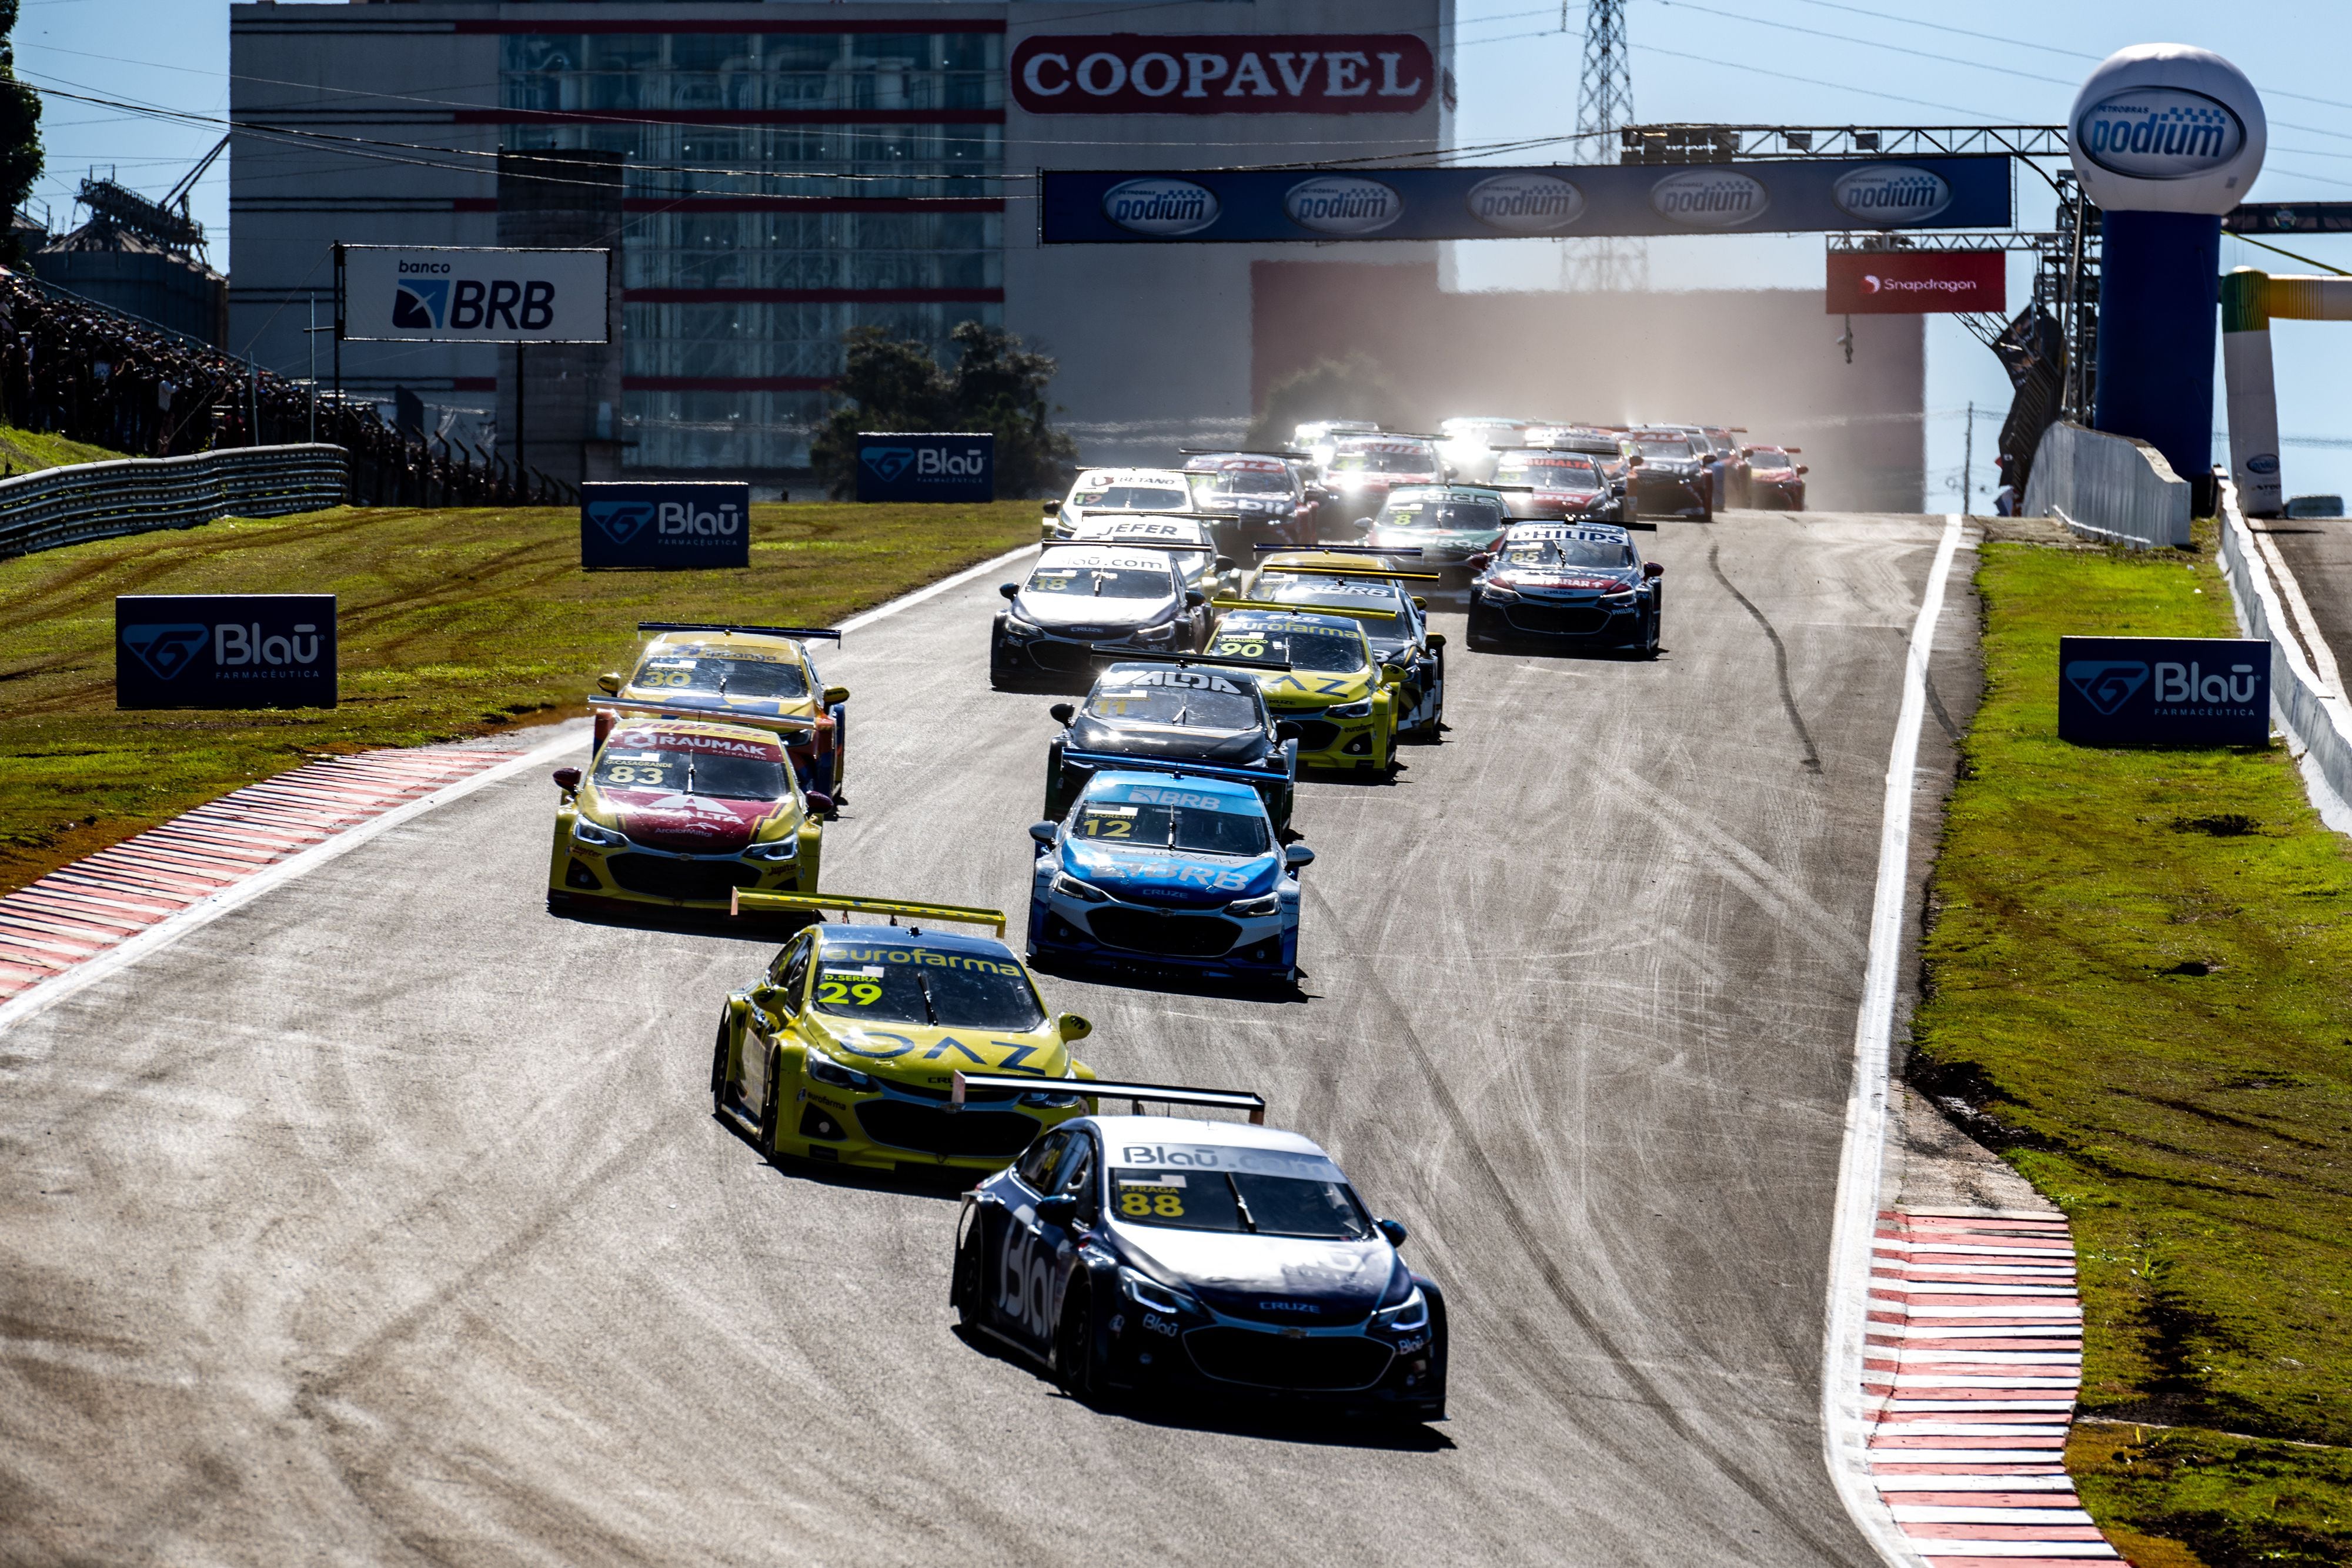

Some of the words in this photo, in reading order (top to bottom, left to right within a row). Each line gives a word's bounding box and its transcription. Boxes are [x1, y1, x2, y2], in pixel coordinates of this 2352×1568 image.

[1023, 52, 1420, 98] COOPAVEL
[2097, 105, 2150, 114] PETROBRAS
[2092, 113, 2225, 157] podium
[1663, 186, 1755, 213] podium
[1846, 182, 1937, 209] podium
[1115, 193, 1205, 221] podium
[1297, 192, 1387, 219] podium
[1481, 190, 1569, 217] podium
[399, 260, 450, 273] banco
[1884, 278, 1977, 292] Snapdragon
[450, 280, 555, 330] BRB
[1202, 499, 1285, 515] obil
[1394, 514, 1411, 526] 8
[1097, 523, 1178, 536] JEFER
[1514, 530, 1624, 544] PHILIPS
[1034, 579, 1068, 591] 18
[1612, 607, 1635, 616] PHILIPS
[707, 650, 777, 662] ipiranga
[1220, 643, 1265, 658] 90
[216, 670, 319, 678] FARMACÊUTICA
[642, 672, 691, 688] 30
[1248, 674, 1349, 698] AZ
[1095, 701, 1127, 714] 11
[2155, 707, 2256, 716] FARMACÊUTICA
[659, 736, 767, 756] RAUMAK
[712, 749, 767, 760] PACKAGING
[606, 759, 673, 768] G.CASAGRANDE
[608, 766, 664, 785] 83
[1160, 790, 1221, 810] BRB
[655, 827, 713, 838] ArcelorMittal
[1084, 819, 1132, 838] 12
[768, 864, 797, 876] Jupiter
[1142, 888, 1189, 899] CRUZE
[826, 948, 1021, 977] eurofarma
[824, 974, 880, 983] D.SERRA
[818, 982, 883, 1006] 29
[807, 1092, 847, 1111] eurofarma
[1120, 1185, 1180, 1195] F.FRAGA
[1121, 1193, 1185, 1217] 88
[1259, 1300, 1321, 1313] CRUZE
